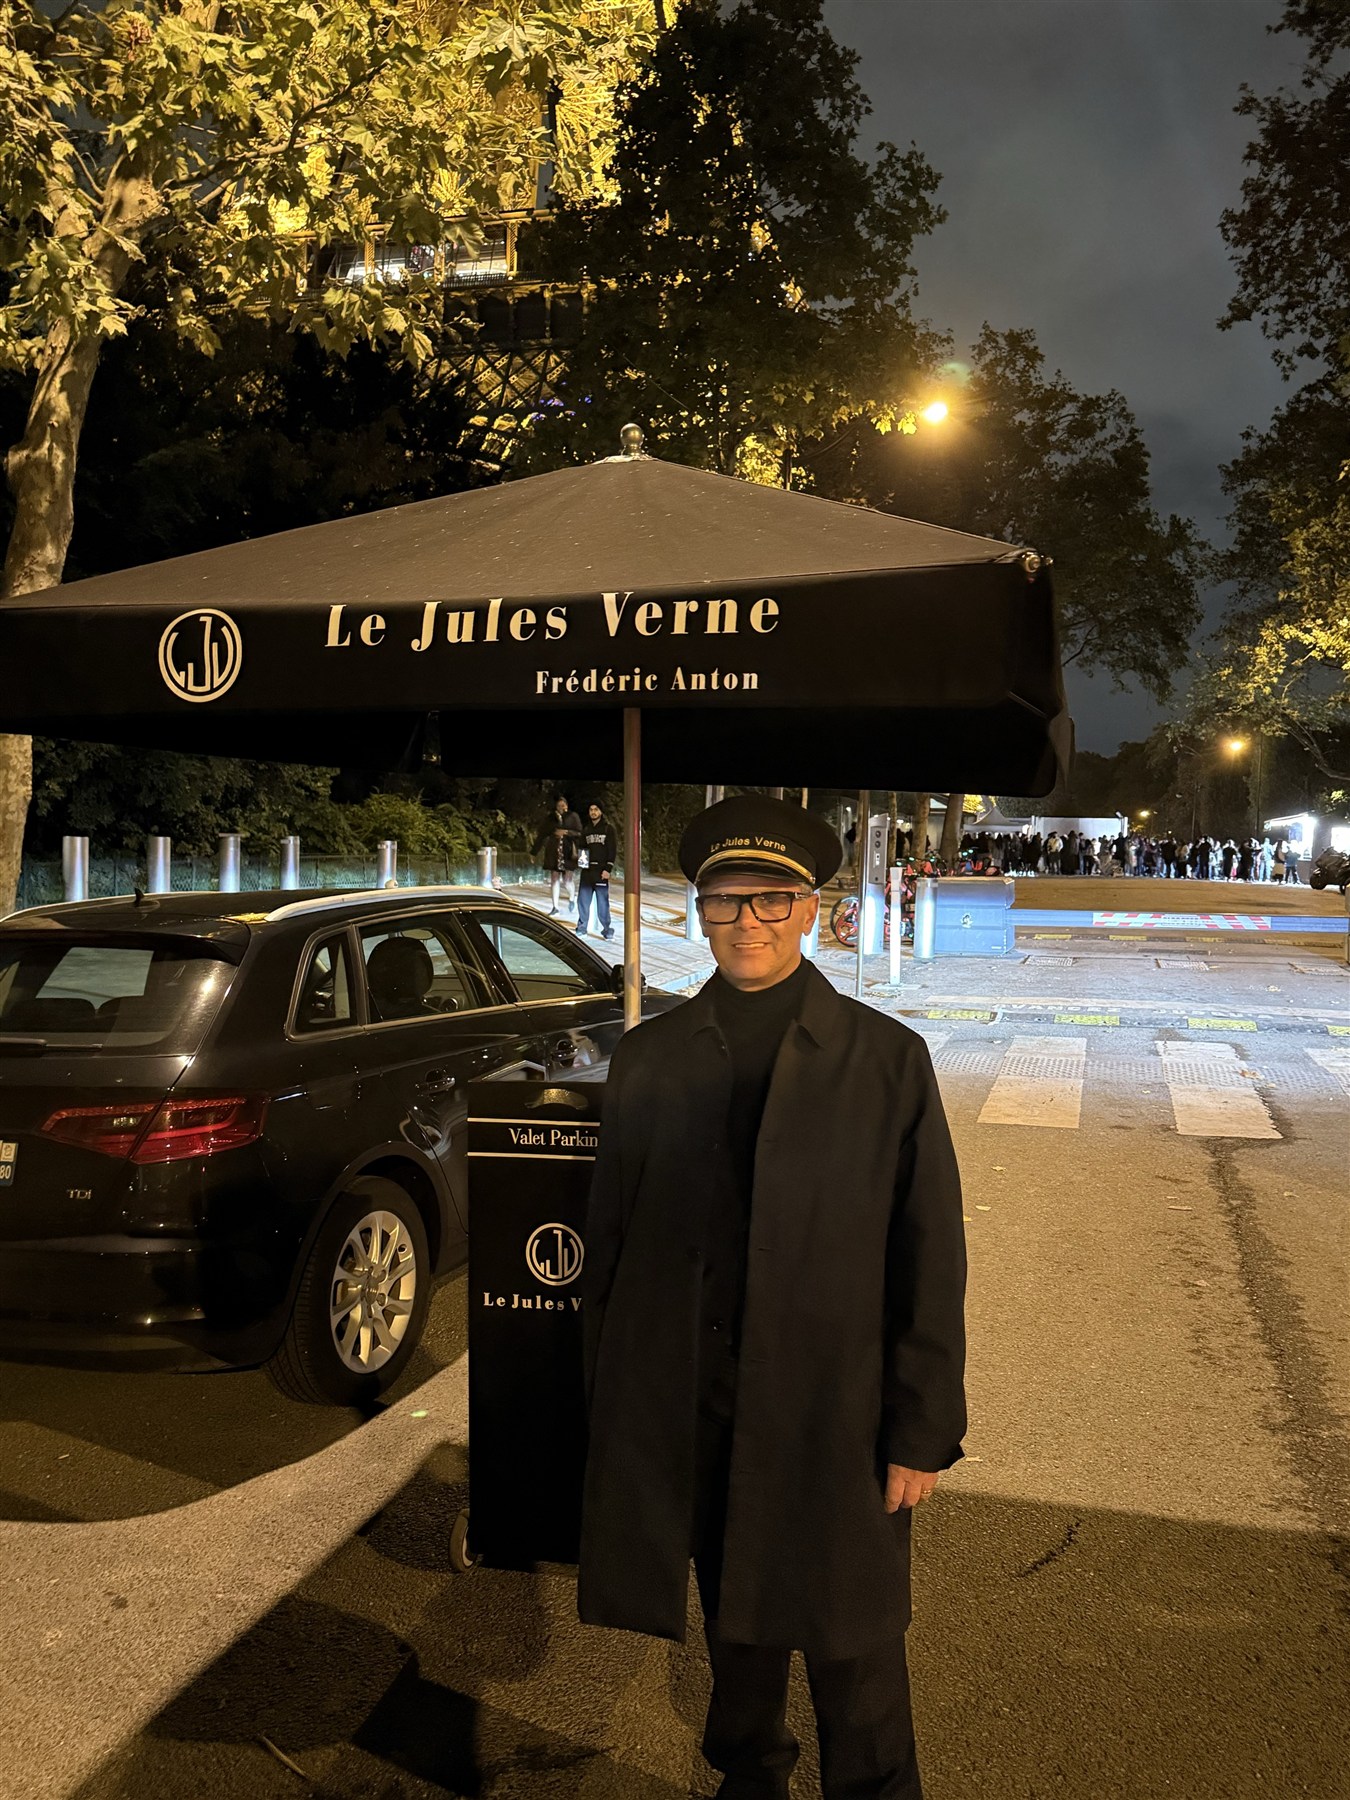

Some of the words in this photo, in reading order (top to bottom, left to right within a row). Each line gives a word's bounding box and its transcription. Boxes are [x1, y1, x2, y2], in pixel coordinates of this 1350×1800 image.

[324, 603, 386, 647] Le
[411, 598, 568, 652] Jules
[601, 591, 780, 637] Verne
[535, 667, 659, 694] Frédéric
[671, 666, 759, 691] Anton
[710, 842, 721, 853] Le
[722, 836, 751, 848] Jules
[755, 836, 787, 852] Verne
[508, 1127, 546, 1146] Valet
[550, 1129, 599, 1148] Parkin
[66, 1188, 92, 1200] TDI
[483, 1292, 506, 1307] Le
[511, 1293, 565, 1311] Jules
[570, 1297, 583, 1312] V
